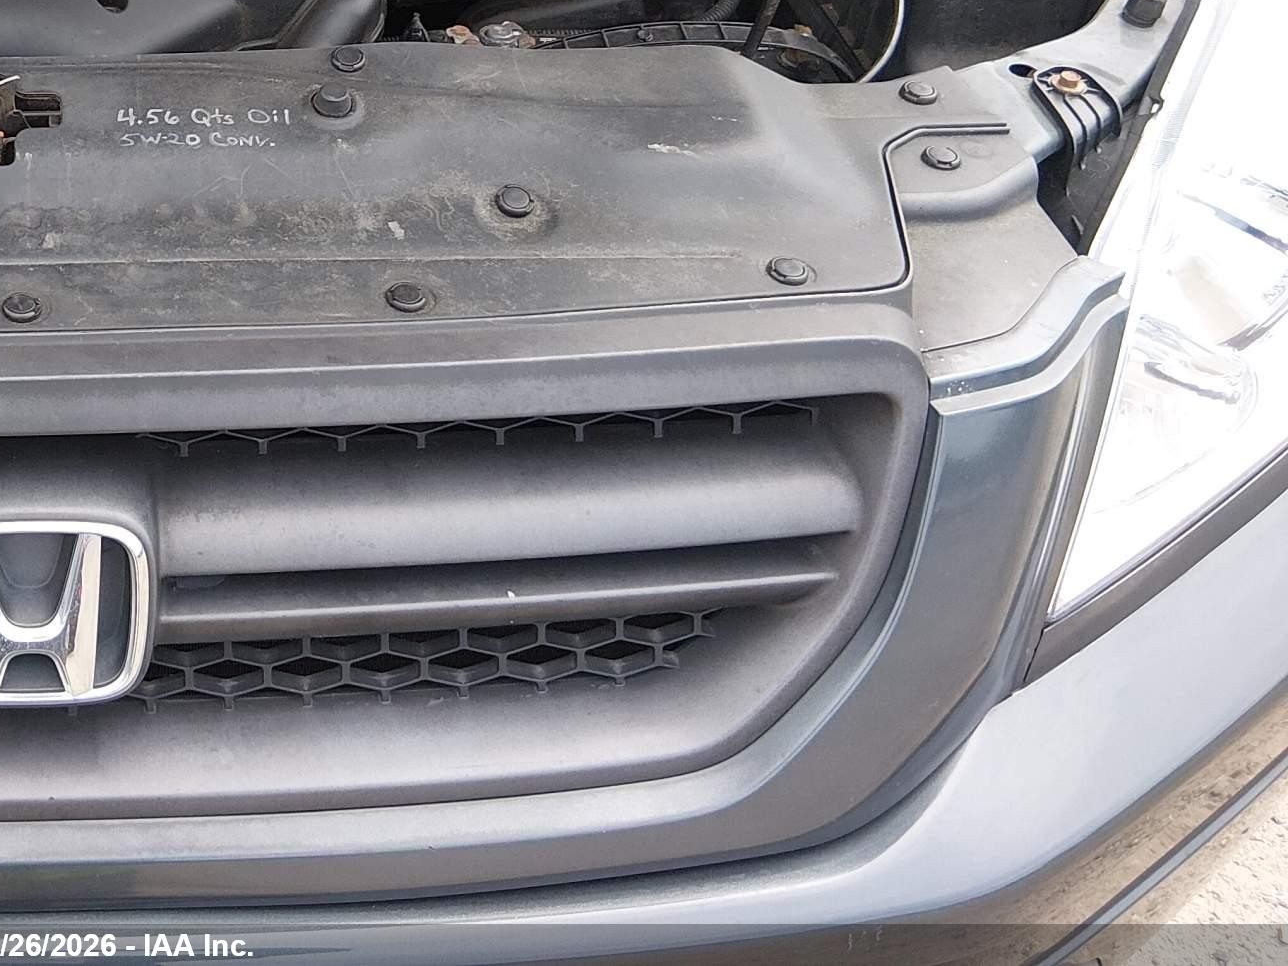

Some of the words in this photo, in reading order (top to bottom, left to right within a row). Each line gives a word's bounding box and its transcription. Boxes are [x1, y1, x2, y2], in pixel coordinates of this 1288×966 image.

[117, 107, 180, 126] 4.56
[191, 108, 235, 127] Qts
[248, 108, 291, 126] Oil
[120, 132, 201, 149] 5W-20
